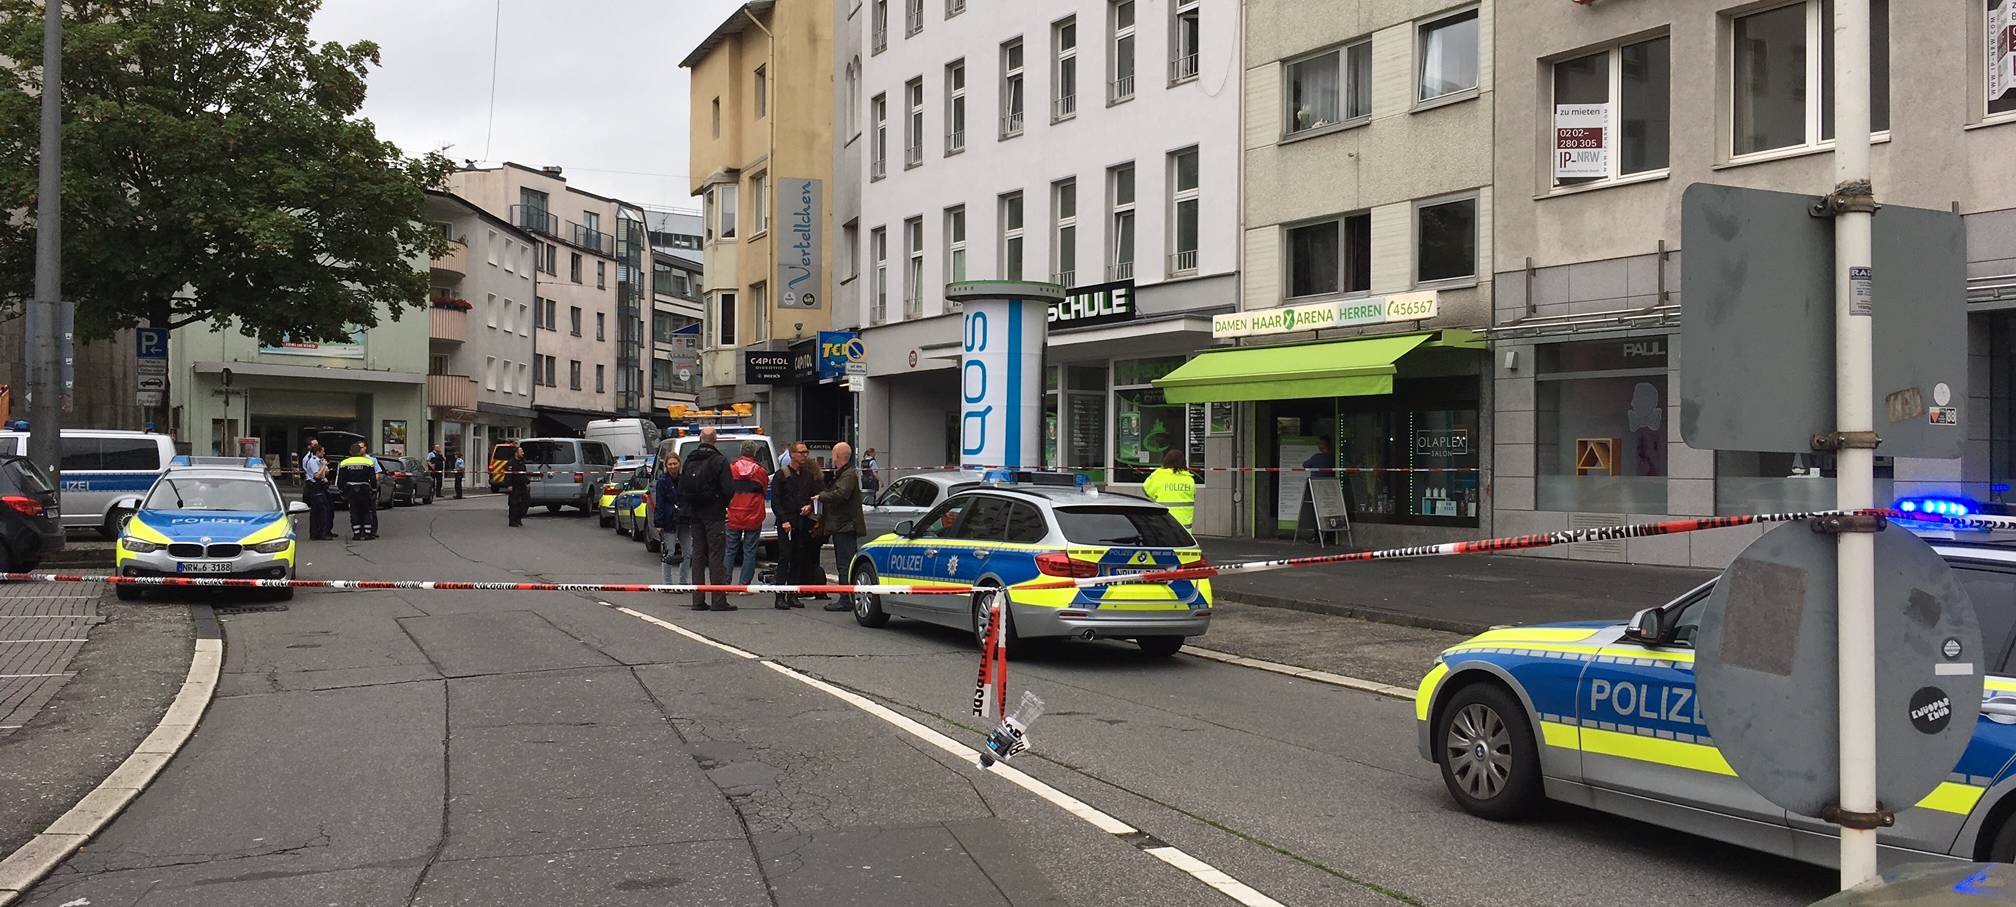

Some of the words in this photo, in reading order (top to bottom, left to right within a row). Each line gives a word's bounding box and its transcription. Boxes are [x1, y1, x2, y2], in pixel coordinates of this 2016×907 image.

[1571, 108, 1600, 116] mieten
[1560, 140, 1577, 148] 280
[1580, 139, 1597, 147] 305
[788, 181, 811, 290] Vertellchen
[1215, 319, 1247, 332] DAMEN
[1252, 316, 1282, 330] HAAR
[1296, 309, 1334, 324] ARENA
[1339, 304, 1382, 320] HERREN
[1393, 300, 1433, 316] 456567
[142, 332, 158, 354] P
[750, 357, 789, 365] CAPITOL
[1418, 437, 1465, 447] OLAPLEX
[60, 480, 90, 491] LIZEI
[1164, 483, 1191, 492] POLIZEI
[182, 562, 198, 572] NRW
[890, 554, 924, 571] POLIZEI
[1590, 678, 1706, 725] POLIZ
